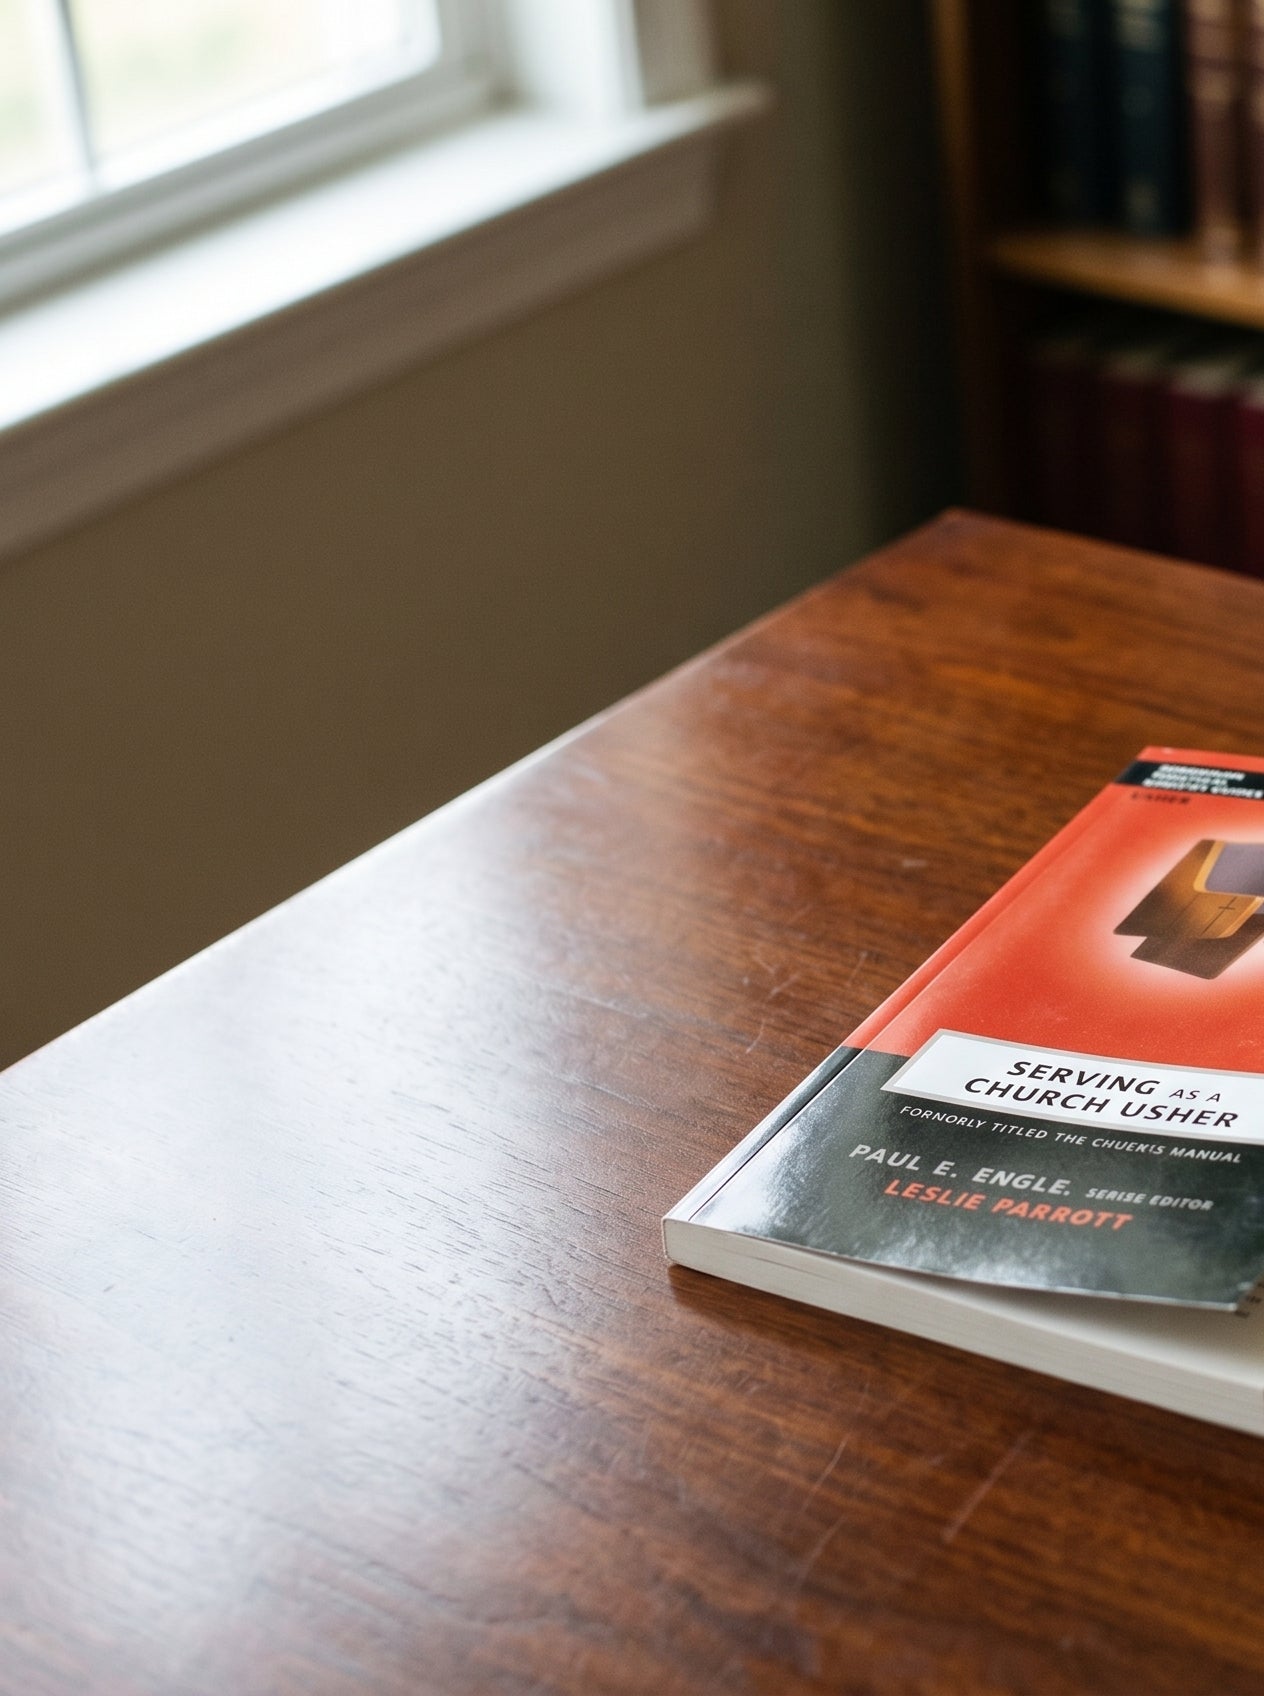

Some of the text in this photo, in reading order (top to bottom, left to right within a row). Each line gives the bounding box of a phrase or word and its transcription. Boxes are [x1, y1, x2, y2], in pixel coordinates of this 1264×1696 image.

[963, 1077, 1240, 1128] CHURCH USHER
[1007, 1060, 1222, 1103] SERVING AS A
[899, 1105, 988, 1129] FORNORLY
[991, 1122, 1049, 1140] TITLED
[1054, 1131, 1088, 1146] THE
[1170, 1146, 1242, 1164] MANUAL
[848, 1143, 921, 1172] PAUL
[932, 1160, 958, 1179] E.
[1149, 1193, 1215, 1212] EDITOR
[884, 1179, 1134, 1231] LESLIE PARROTT
